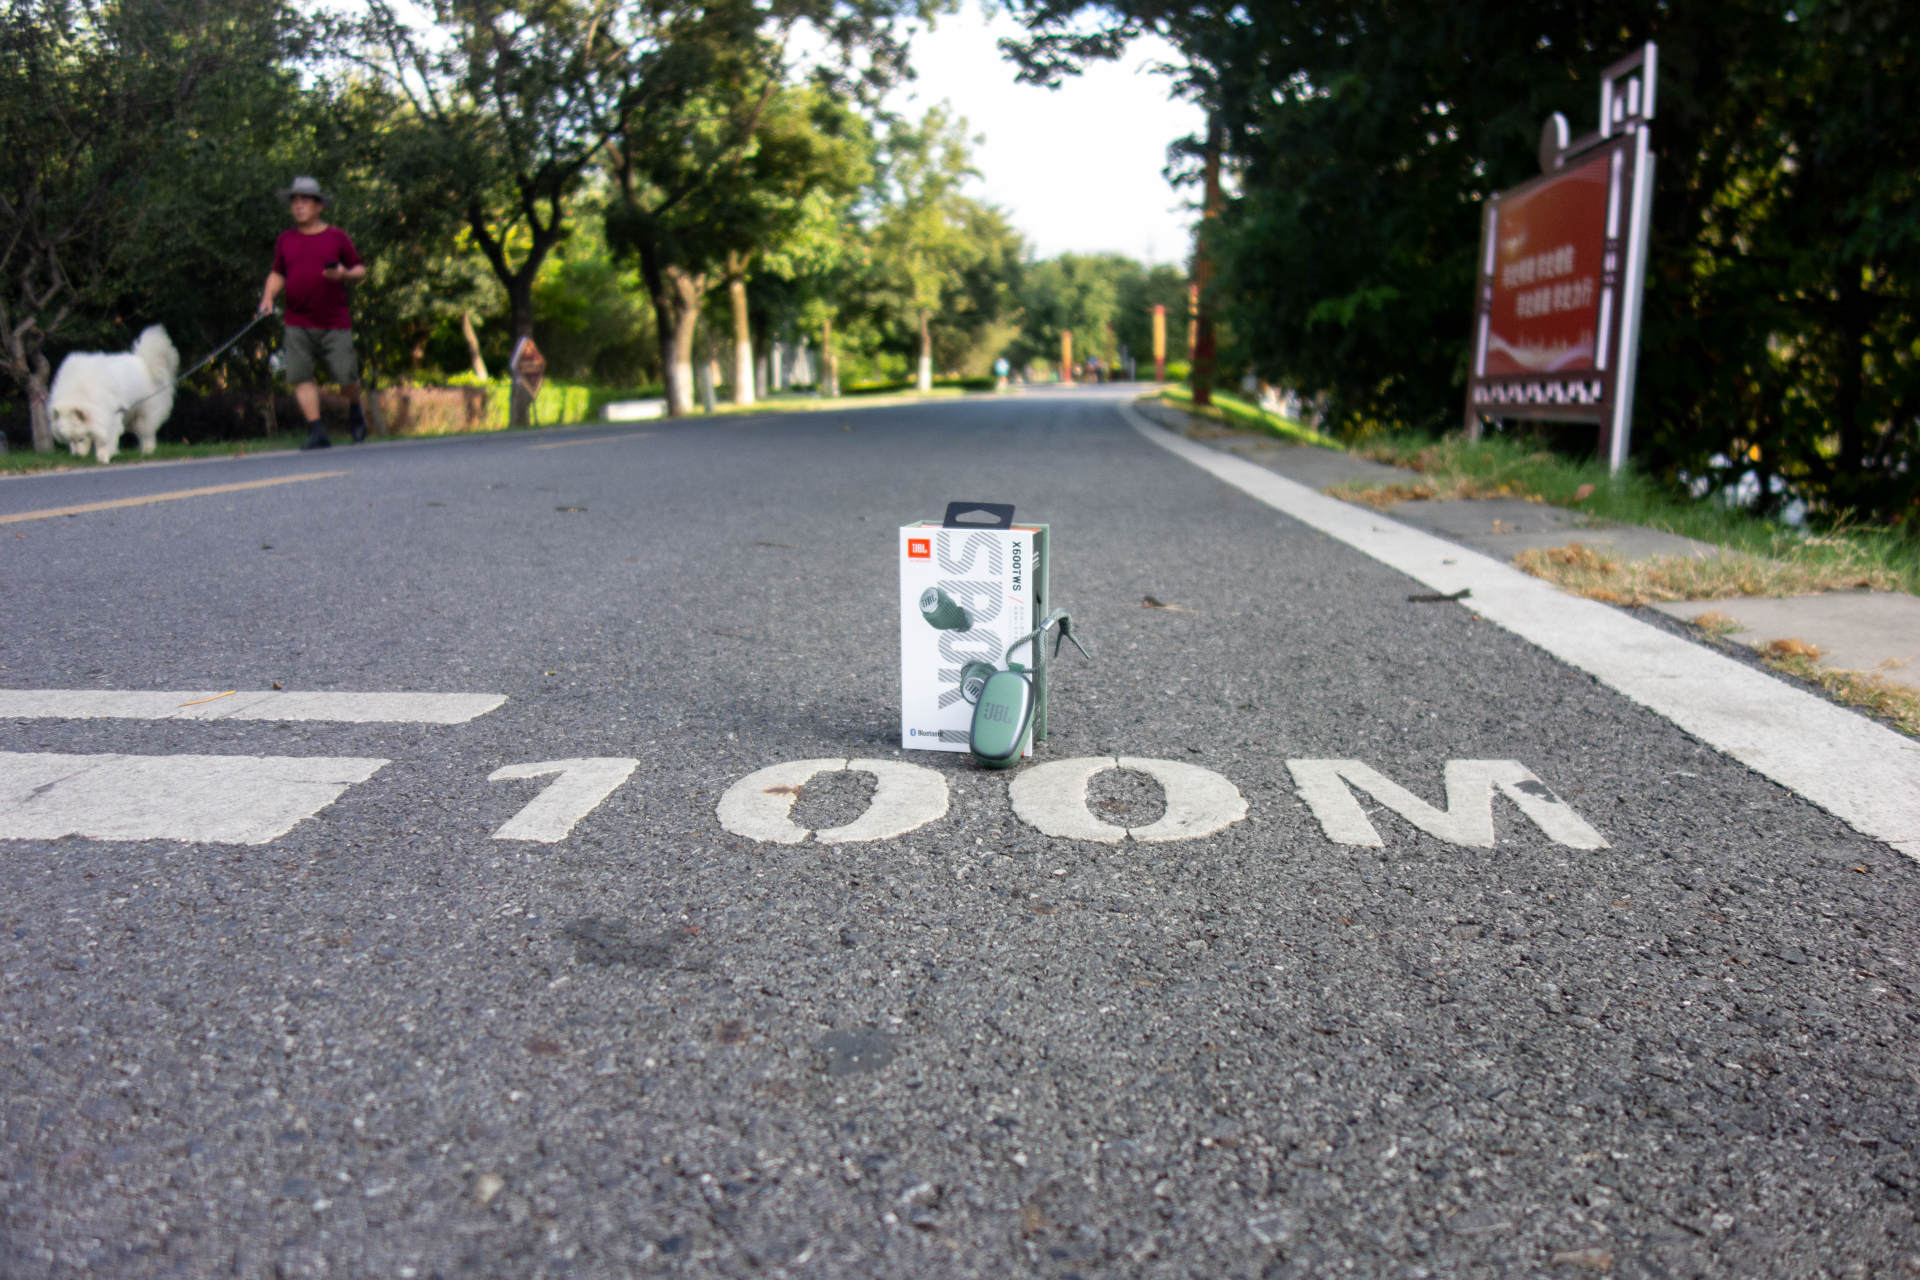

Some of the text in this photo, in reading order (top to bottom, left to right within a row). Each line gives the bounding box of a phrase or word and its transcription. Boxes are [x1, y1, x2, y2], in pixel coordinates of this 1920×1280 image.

[912, 543, 928, 553] JBL
[1012, 541, 1022, 592] X600TWS
[937, 530, 1003, 744] SPO
[984, 702, 1012, 724] JBL
[487, 756, 1611, 849] 100M
